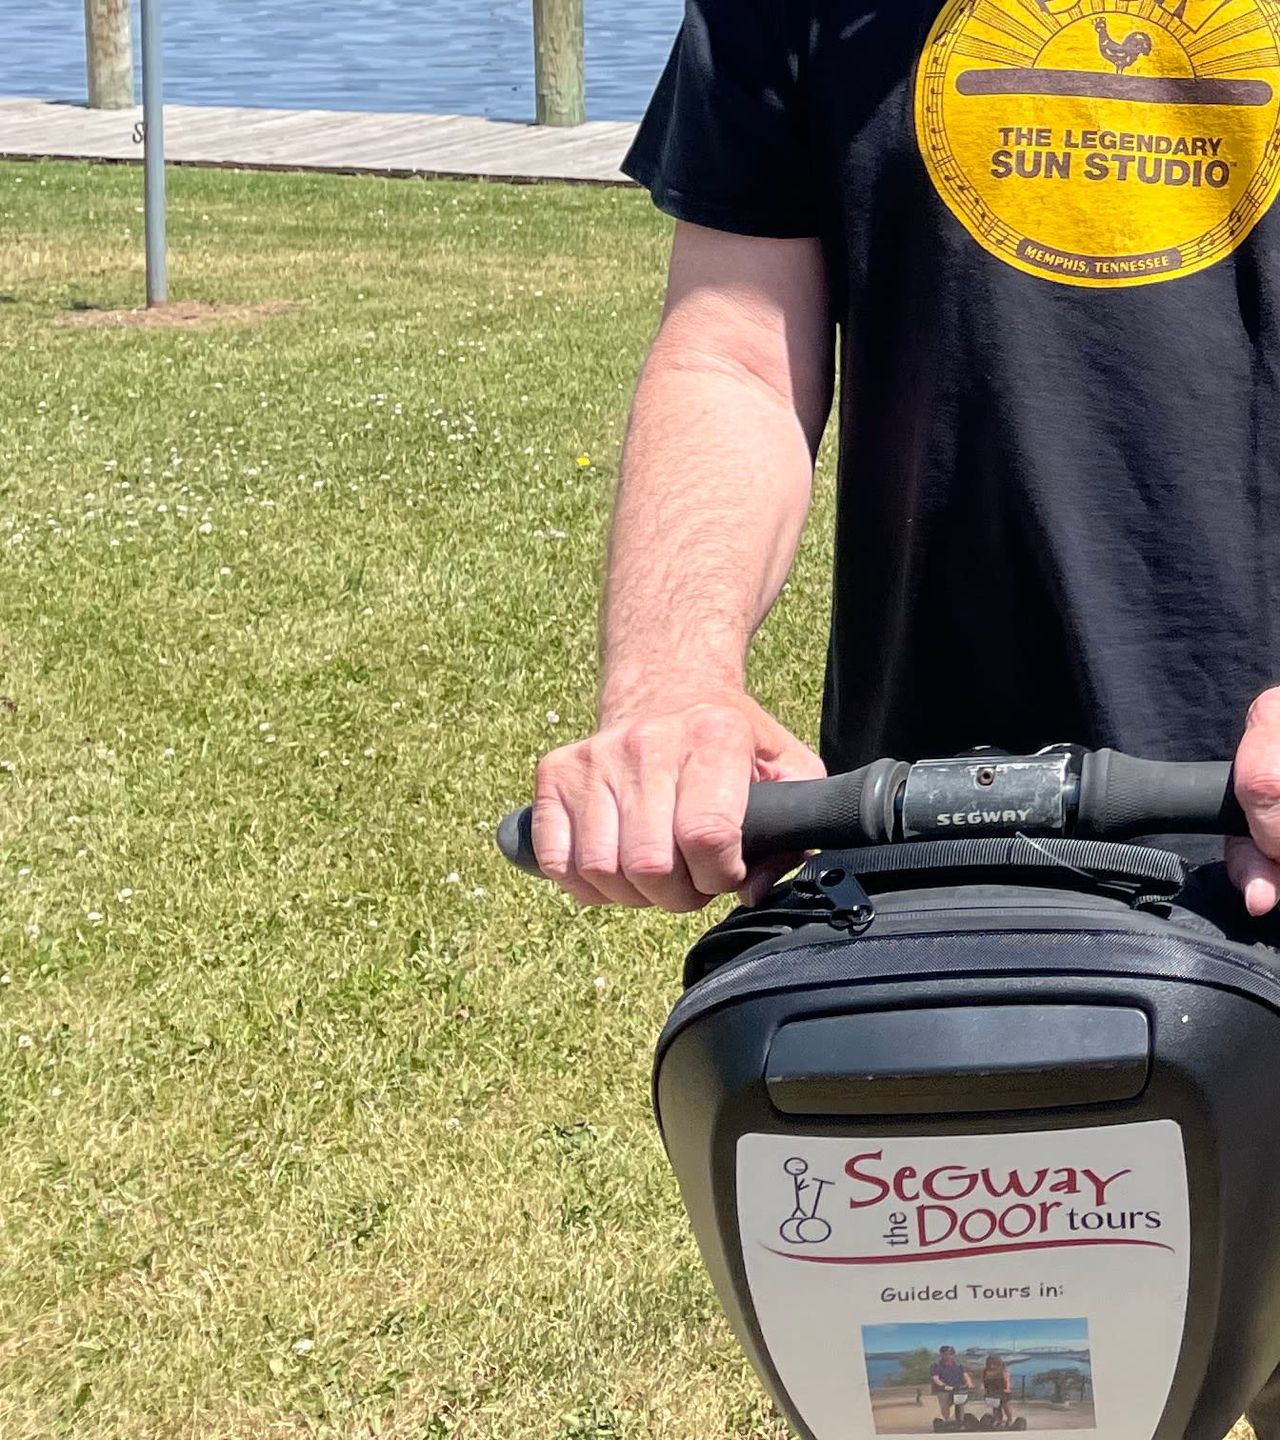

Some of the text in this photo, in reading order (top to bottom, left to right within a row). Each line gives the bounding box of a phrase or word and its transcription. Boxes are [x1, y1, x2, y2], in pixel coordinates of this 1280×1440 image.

[998, 127, 1223, 157] THE LEGENDARY
[990, 150, 1230, 188] SUN STUDIO
[1024, 245, 1170, 274] MEMPHIS, TENNESSEE
[936, 809, 1031, 826] SEGWAY
[882, 1200, 1162, 1247] the Door tours
[880, 1281, 1064, 1304] Guided Tours in:
